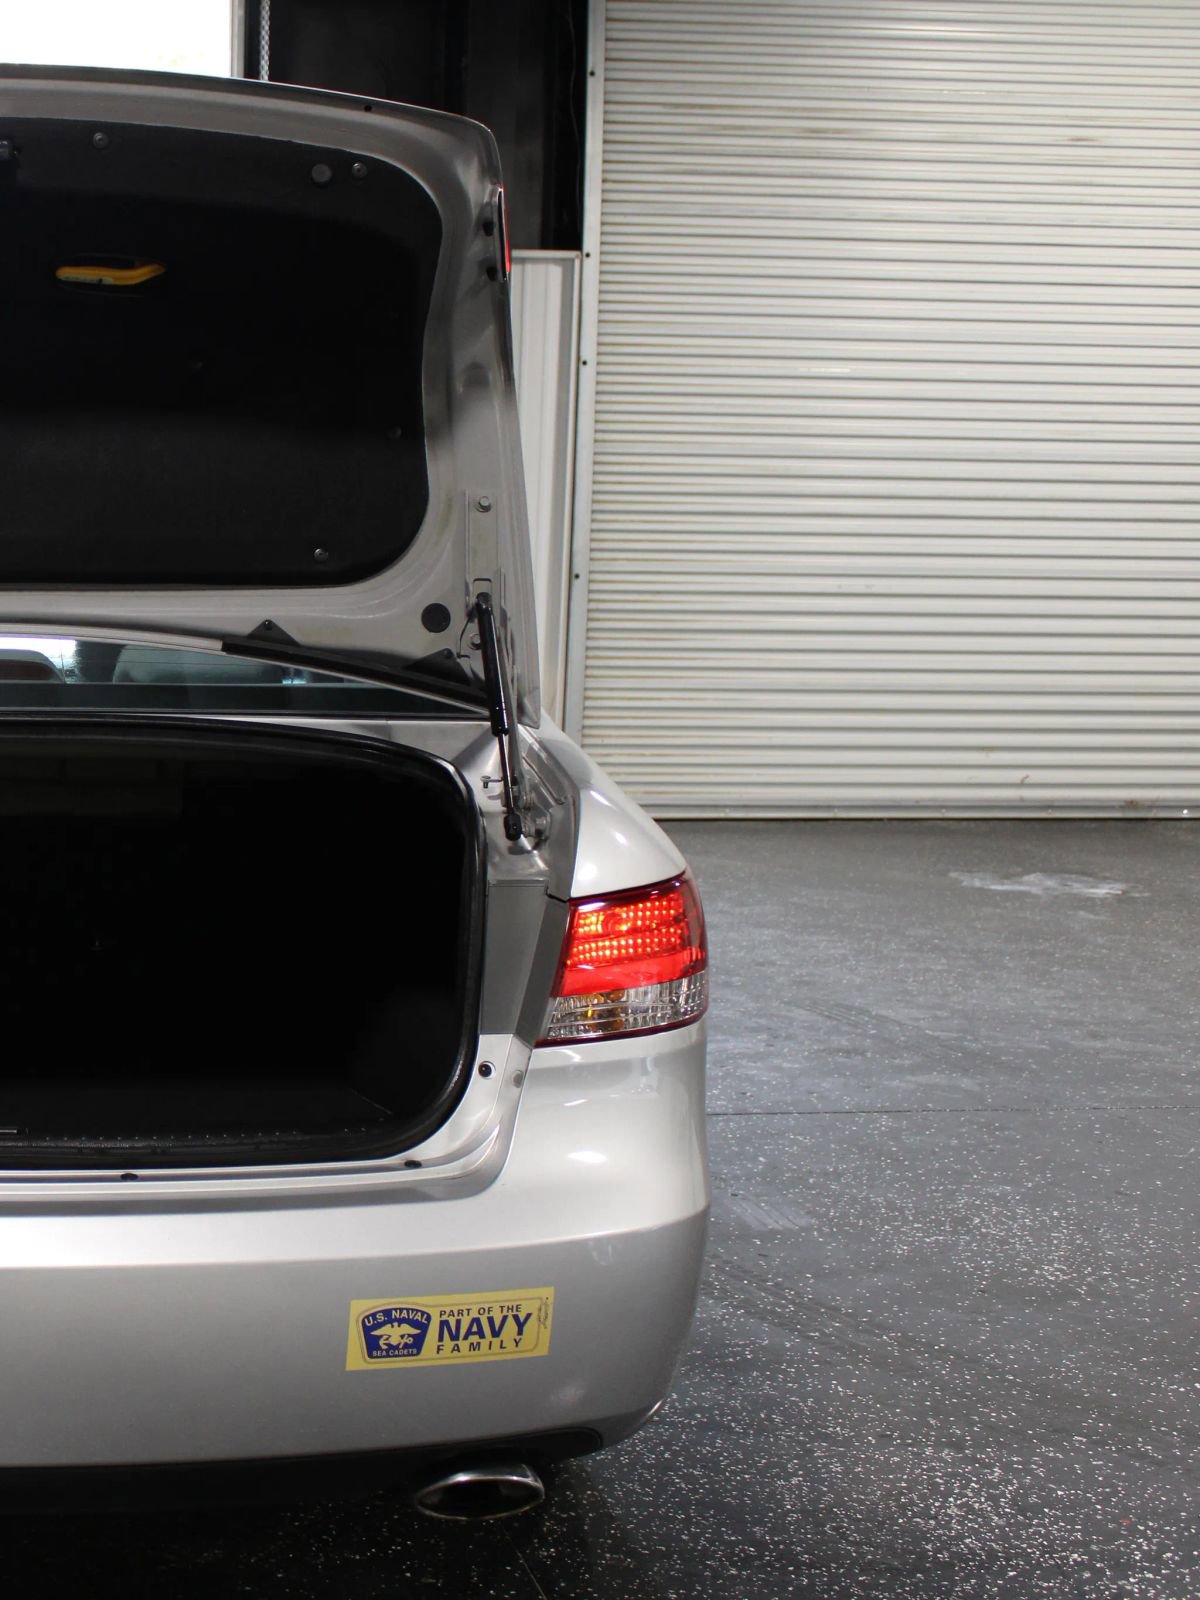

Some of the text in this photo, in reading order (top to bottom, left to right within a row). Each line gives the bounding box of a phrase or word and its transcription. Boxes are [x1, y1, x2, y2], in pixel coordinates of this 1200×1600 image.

[364, 1309, 428, 1327] U.S. NAVAL
[439, 1304, 522, 1319] PART OF THE
[437, 1312, 533, 1343] NAVY
[388, 1348, 418, 1357] CADETS
[436, 1338, 522, 1355] FAMILY
